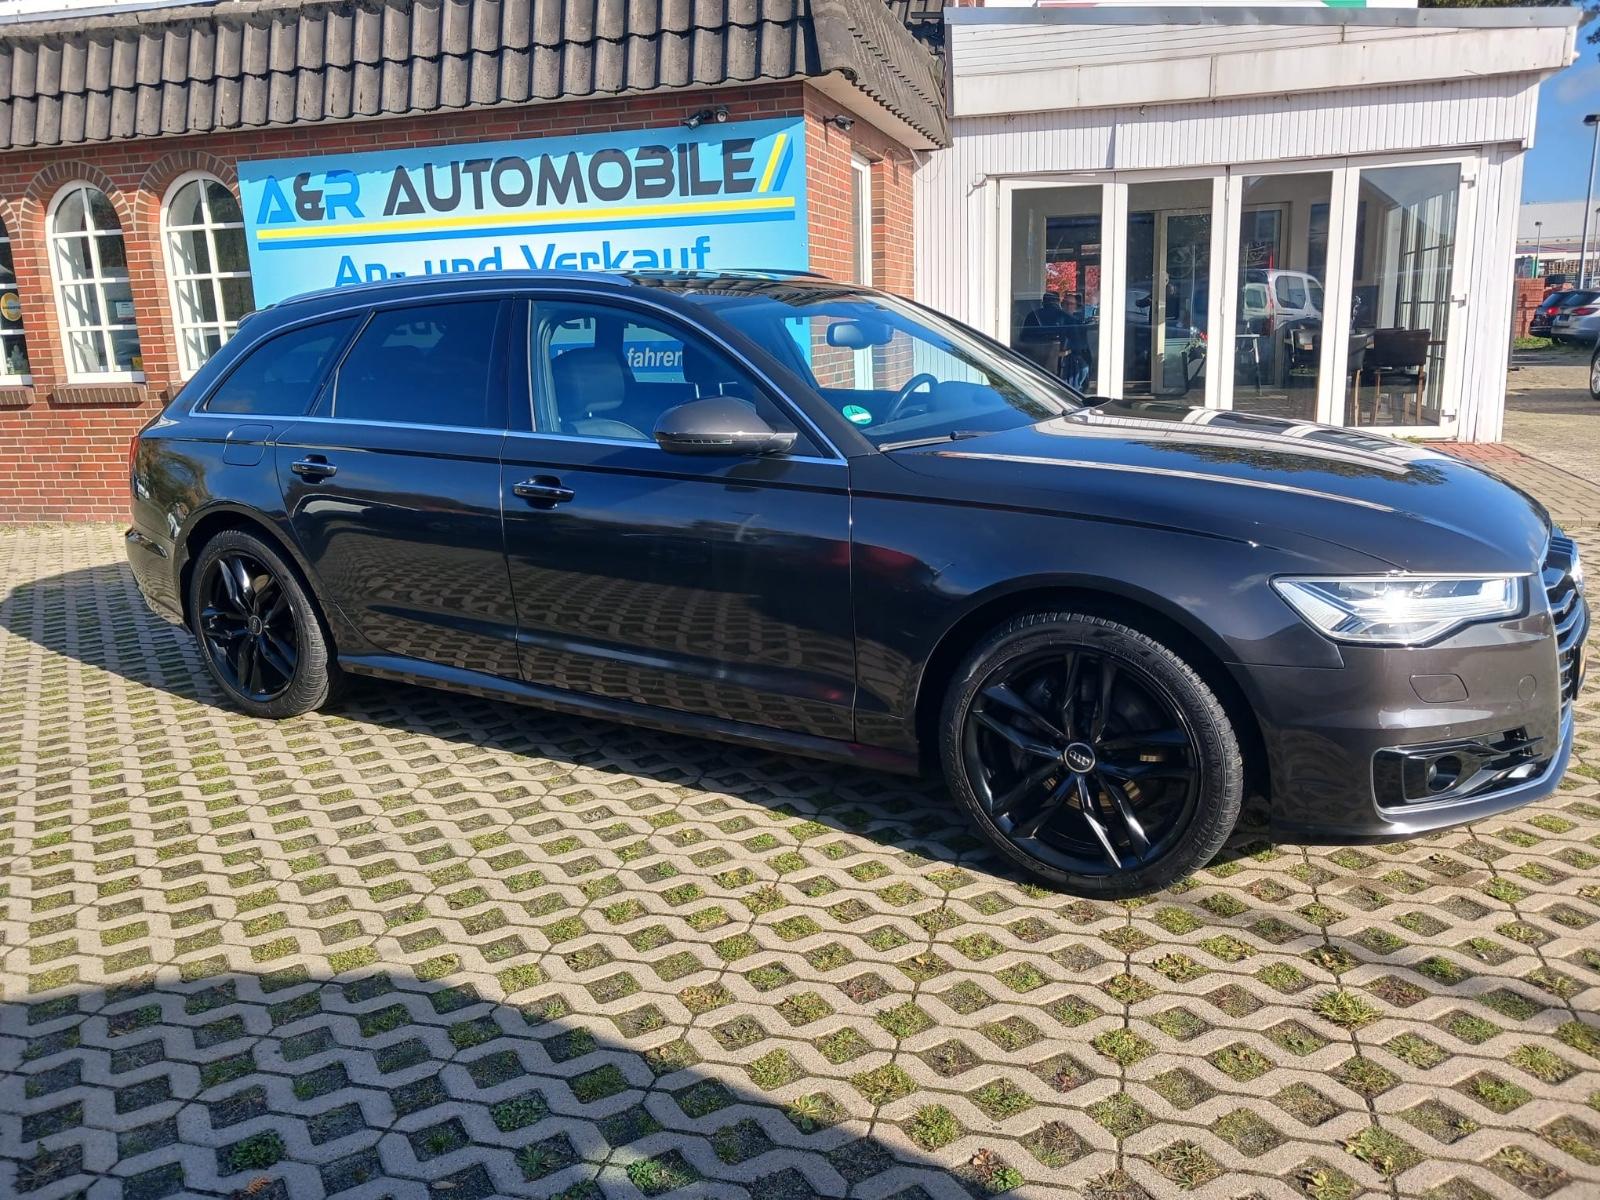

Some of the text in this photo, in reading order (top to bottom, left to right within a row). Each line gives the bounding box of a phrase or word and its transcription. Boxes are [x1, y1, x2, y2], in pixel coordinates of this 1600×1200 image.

[256, 137, 756, 224] A&R AUTOMOBILE
[520, 236, 710, 270] Verkauf
